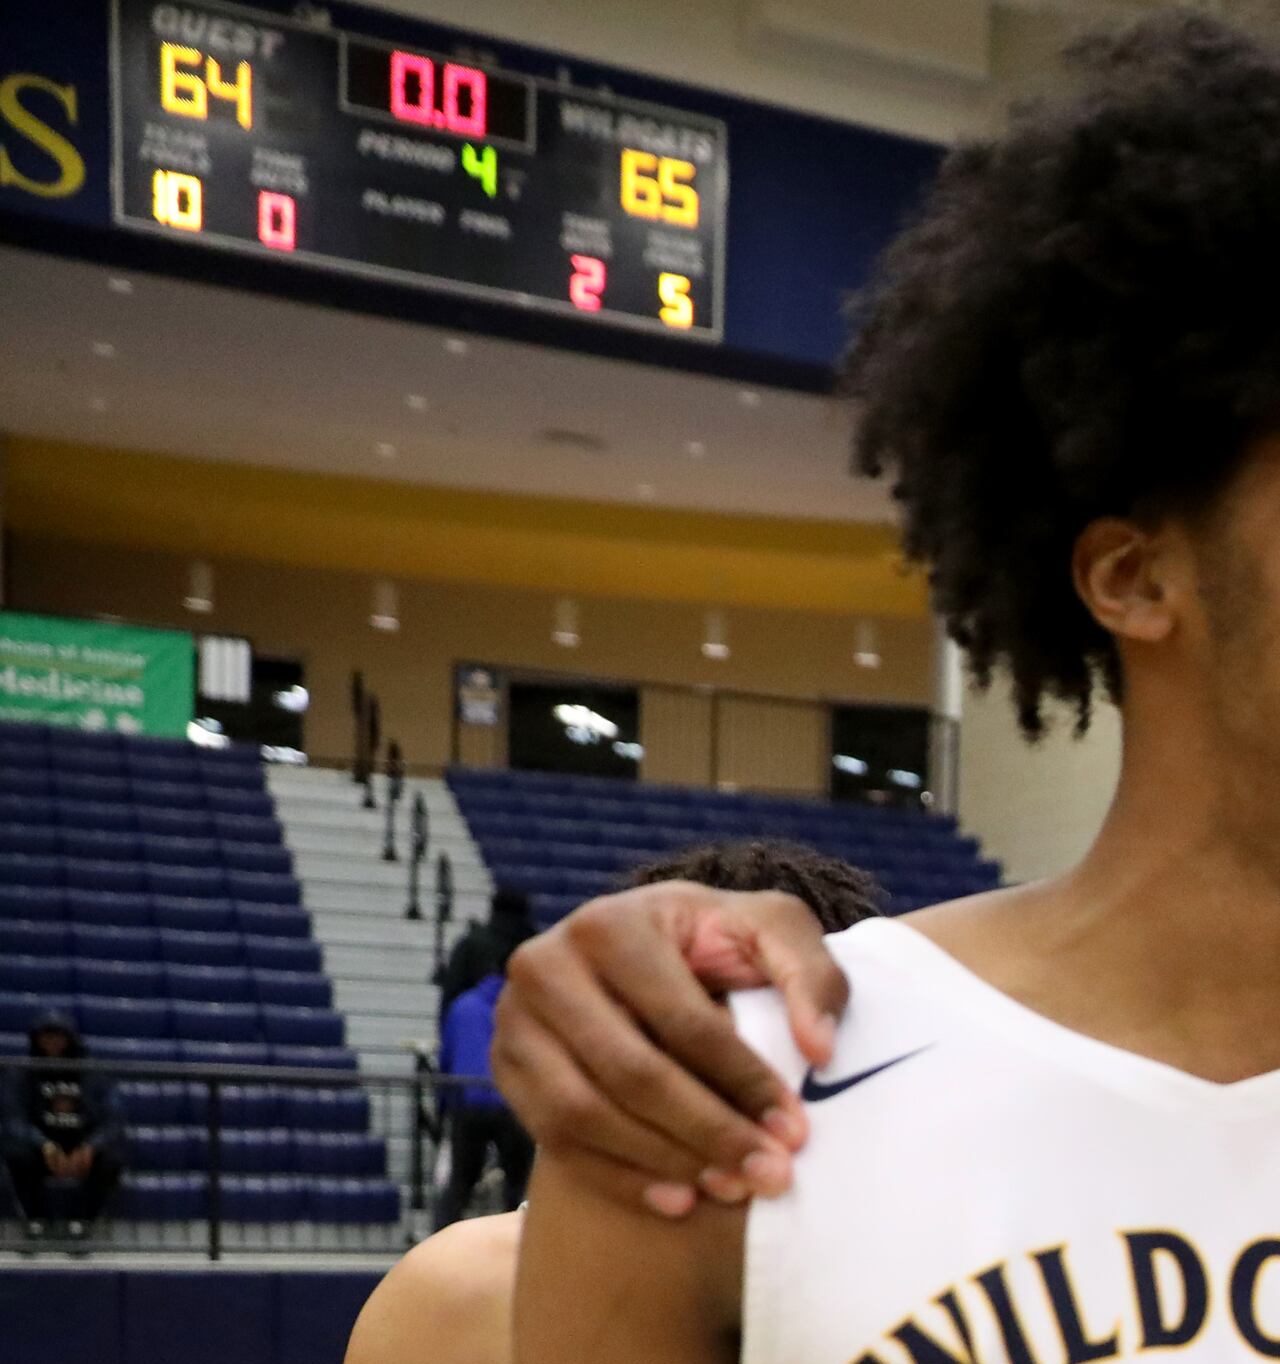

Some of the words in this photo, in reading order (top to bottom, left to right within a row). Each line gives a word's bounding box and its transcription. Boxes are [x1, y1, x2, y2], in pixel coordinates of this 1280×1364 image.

[152, 3, 284, 58] GUEST
[160, 42, 253, 132] 64
[390, 49, 487, 141] 0.0
[153, 168, 202, 232] 10
[461, 142, 497, 199] 4
[620, 147, 699, 230] 65
[258, 190, 296, 253] 0
[569, 253, 607, 313] 2
[658, 271, 694, 331] 5
